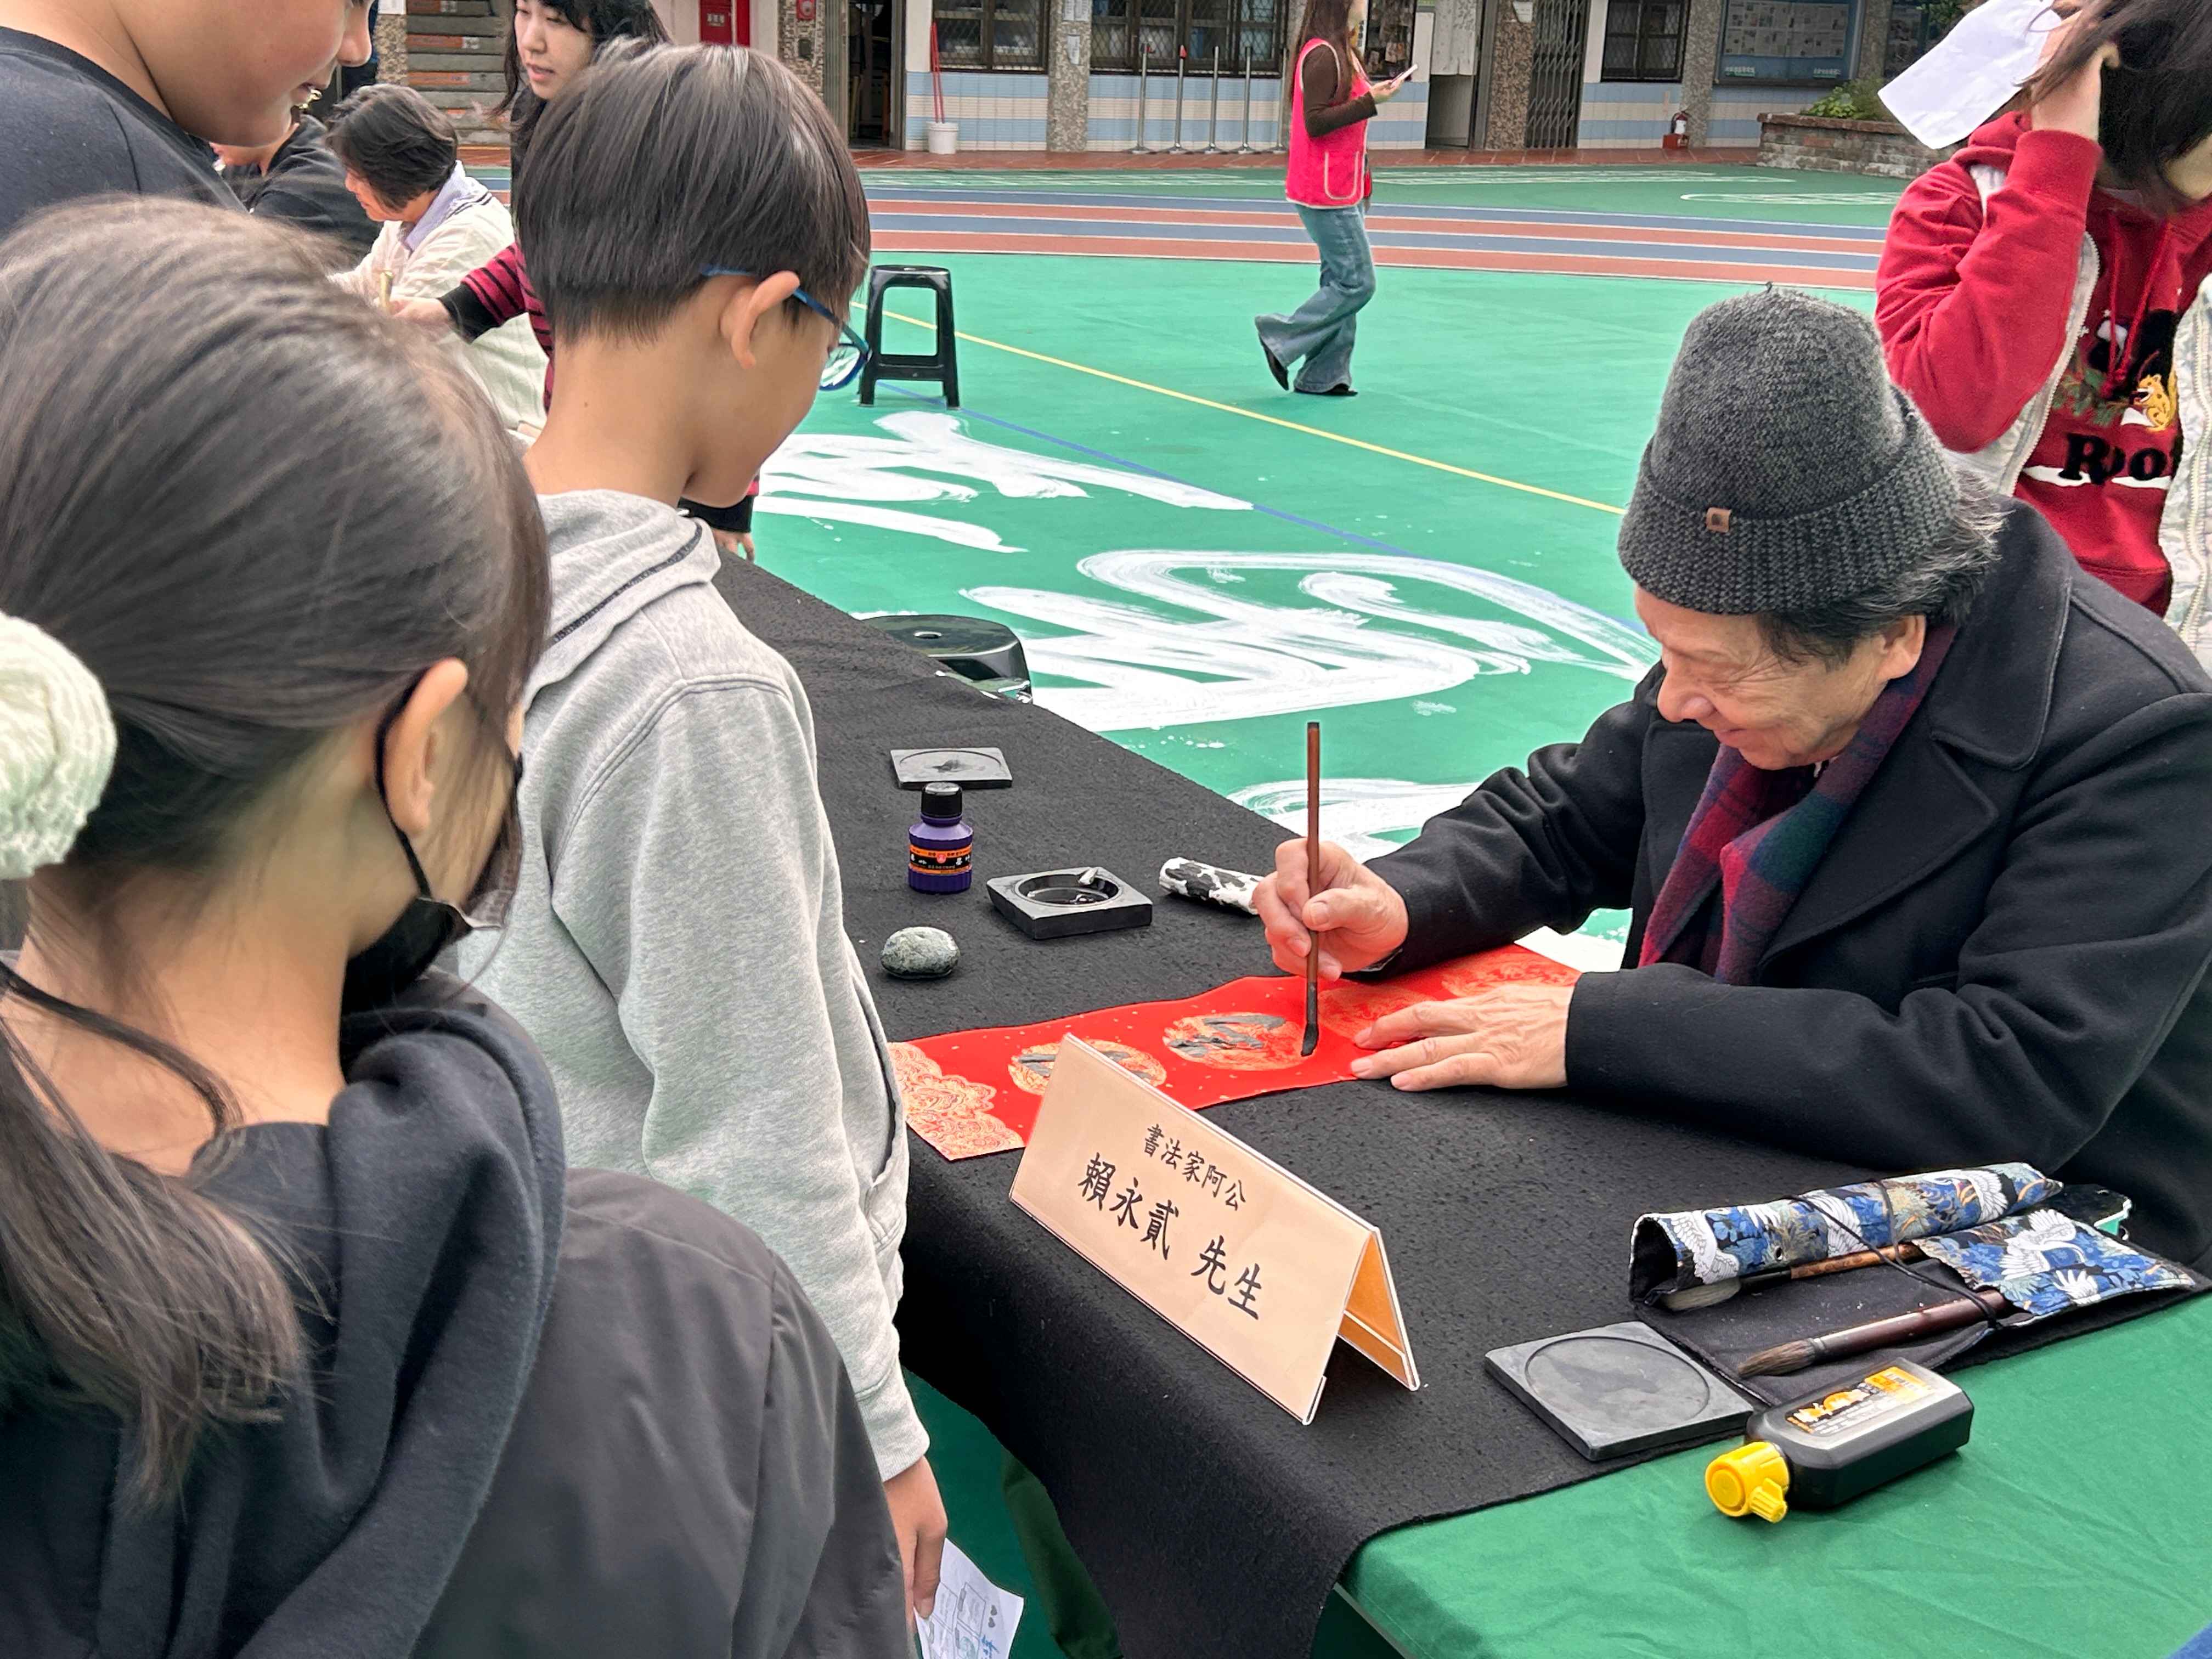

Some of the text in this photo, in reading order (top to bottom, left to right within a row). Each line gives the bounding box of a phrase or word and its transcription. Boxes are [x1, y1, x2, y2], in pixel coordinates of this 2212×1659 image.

[1143, 1123, 1246, 1211] 書法家阿公
[1077, 1152, 1263, 1320] 賴永貳 先生
